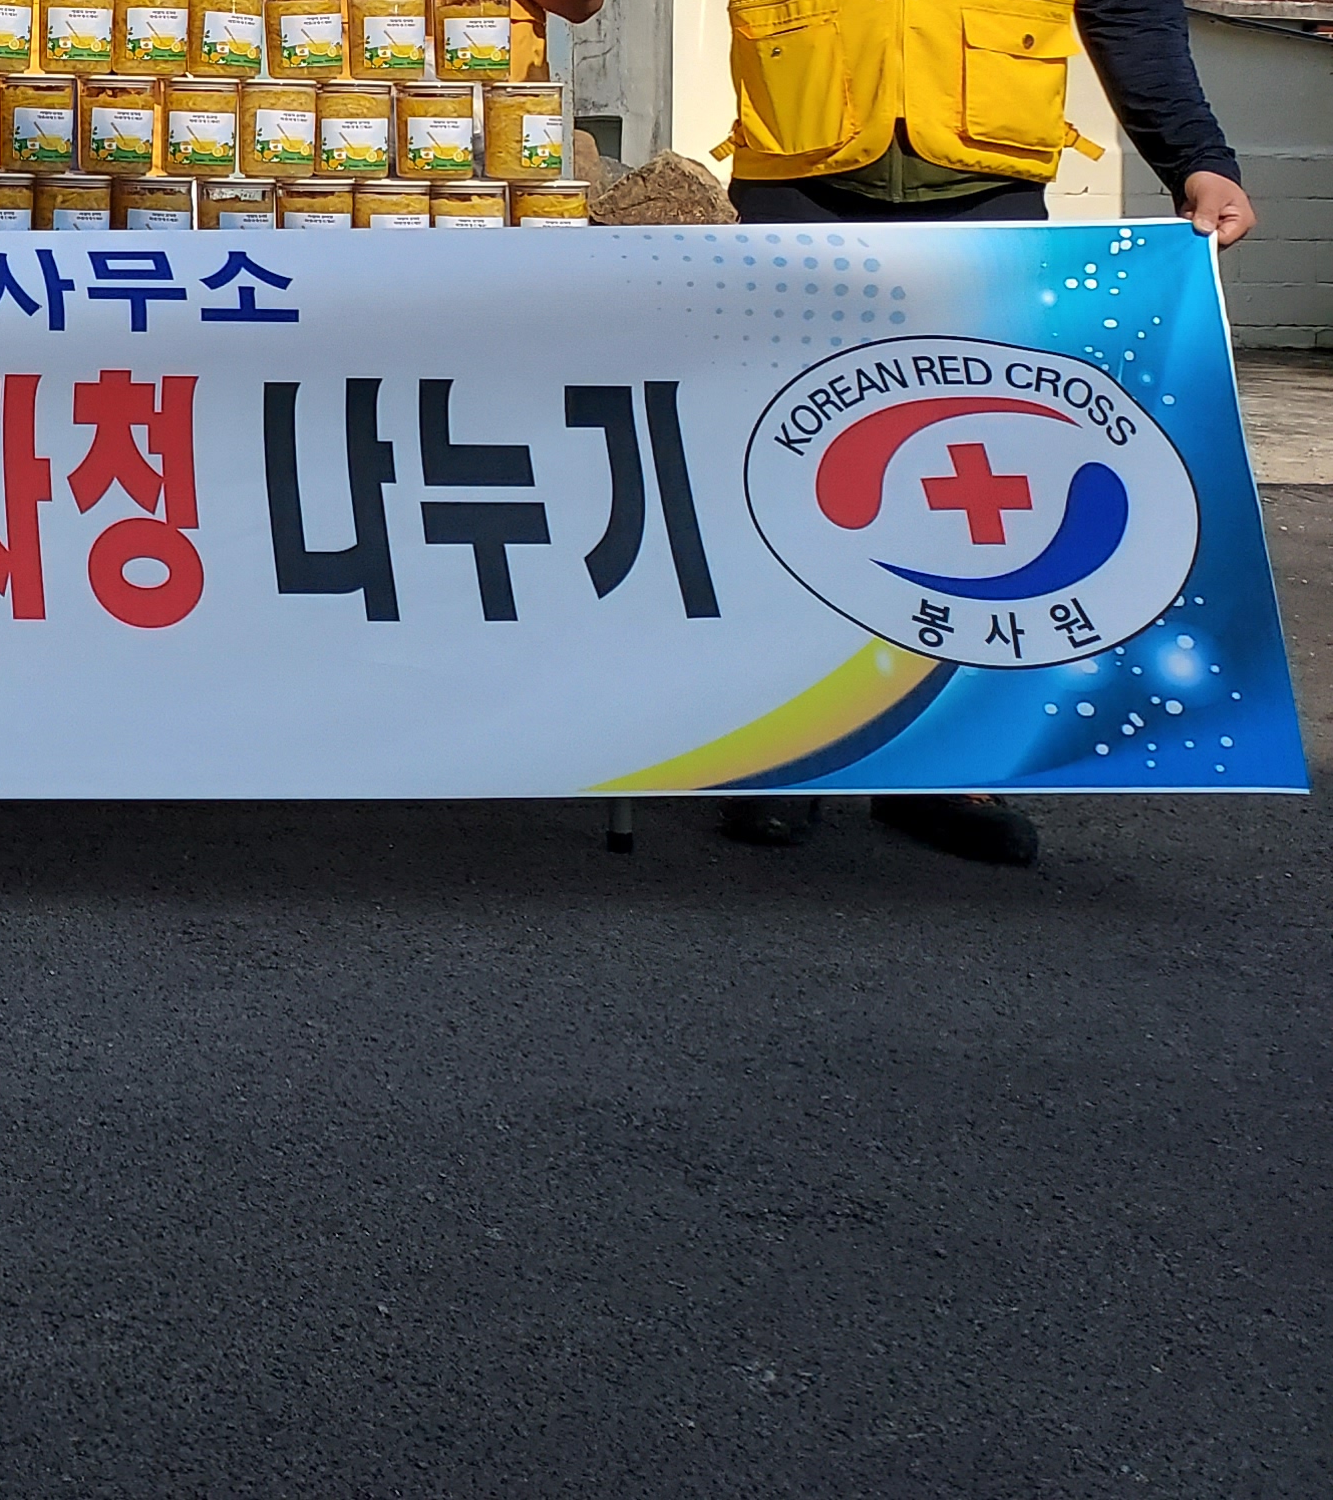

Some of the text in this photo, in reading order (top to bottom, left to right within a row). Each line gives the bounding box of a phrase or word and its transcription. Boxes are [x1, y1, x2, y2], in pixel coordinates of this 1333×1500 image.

[773, 354, 1137, 457] KOREAN RED CROSS
[261, 376, 722, 624] 나누기
